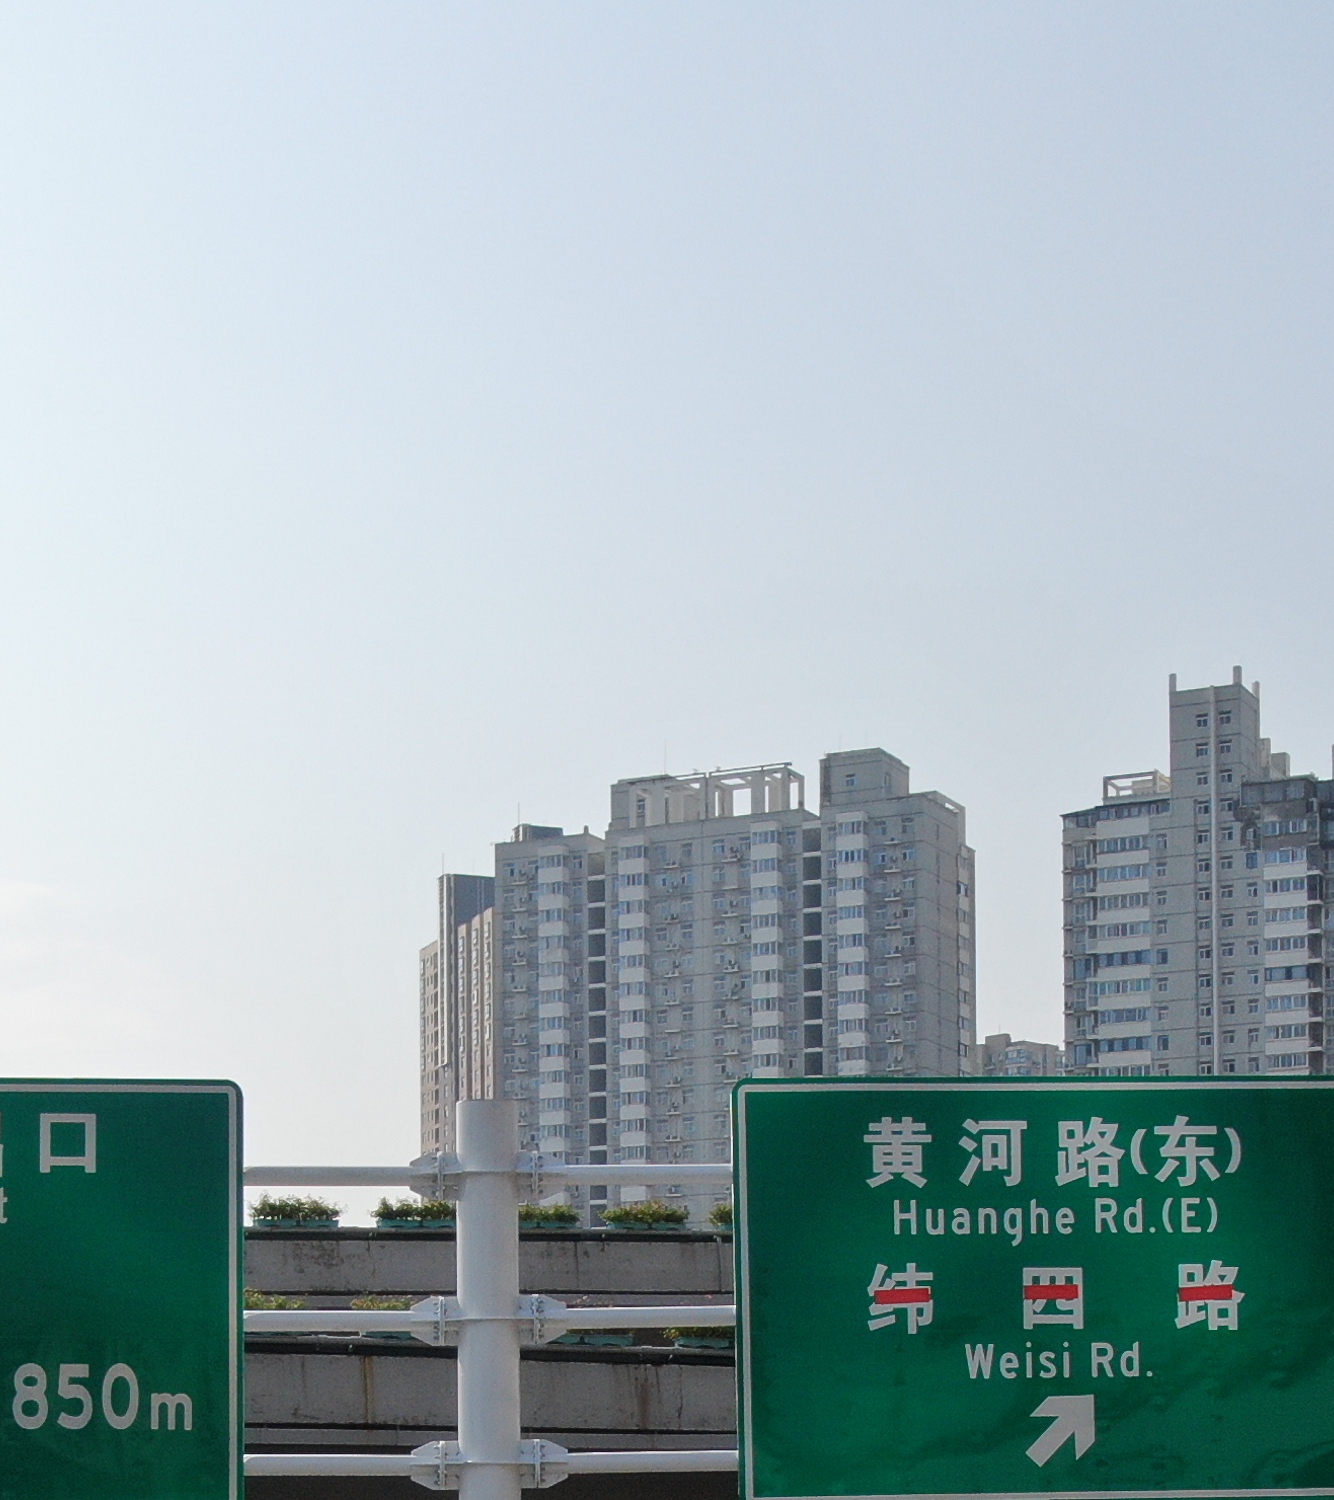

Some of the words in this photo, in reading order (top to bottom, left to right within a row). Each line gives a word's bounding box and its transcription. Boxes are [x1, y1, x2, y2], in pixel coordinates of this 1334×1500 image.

[863, 1115, 1241, 1189] 黄河路(东)
[893, 1198, 1076, 1247] Huanghe
[867, 1259, 1246, 1335] 纬四路
[964, 1341, 1071, 1379] Weisi
[1090, 1341, 1154, 1379] Rd.
[12, 1362, 193, 1431] 850m
